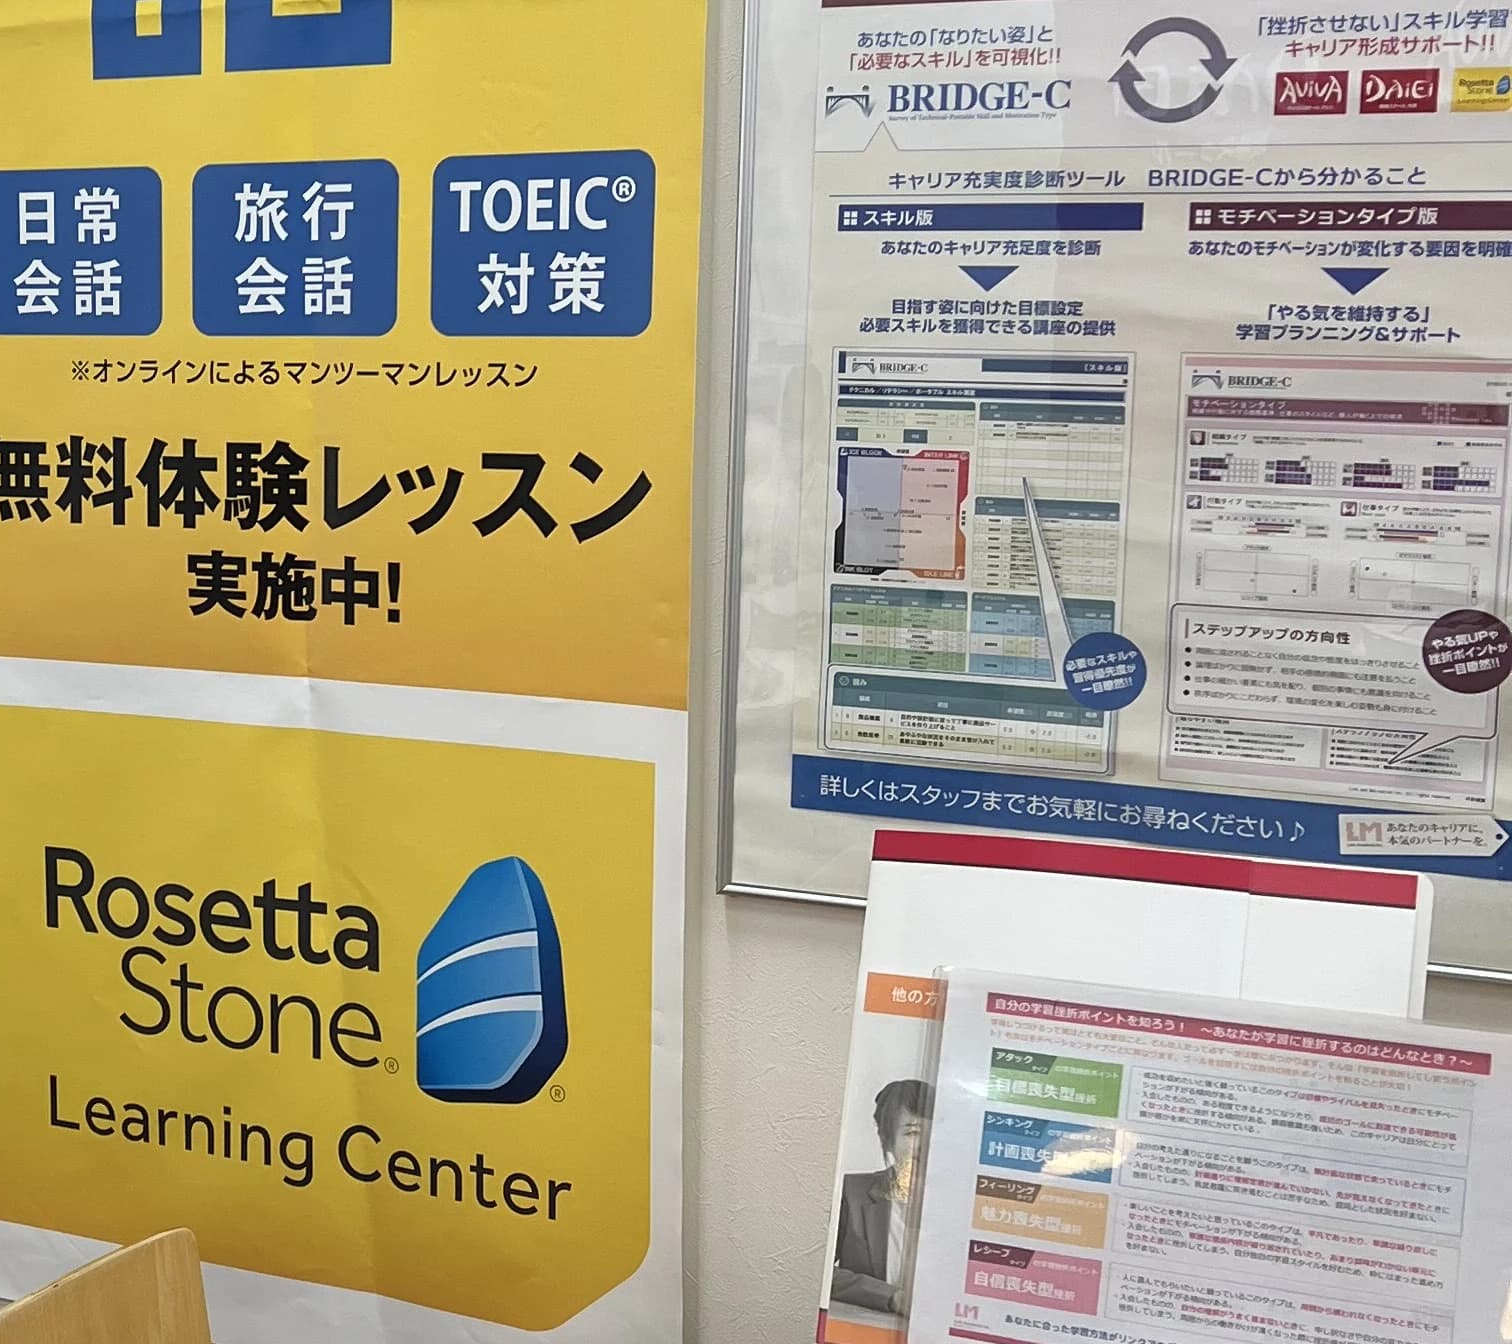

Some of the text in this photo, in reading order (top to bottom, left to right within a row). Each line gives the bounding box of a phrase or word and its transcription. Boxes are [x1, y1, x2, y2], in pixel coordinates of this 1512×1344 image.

[1257, 9, 1510, 37] 「挫折させない」スキル学習
[857, 25, 1053, 47] あなたの「なりたい姿」と
[887, 80, 1072, 112] BRIDGE-C
[889, 167, 1427, 190] キャリア充実度診断ツール BRIDGE-Cから分かること
[18, 187, 121, 245] 日常
[234, 181, 355, 243] 旅行
[863, 210, 933, 226] スキル版
[1218, 207, 1438, 226] モチベーションタイプ版
[881, 240, 1101, 256] あなたのキャリア充足度を診断
[13, 258, 123, 316] 会話
[235, 256, 354, 316] 会話
[477, 251, 607, 315] 対策
[891, 299, 1083, 316] 目指す姿に向けた目標設定
[1267, 304, 1430, 323] 「やる気を維持する」
[859, 319, 1116, 337] 必要スキルを獲得できる講座の提供
[71, 359, 538, 389] ※オンラインによるマンツーマンレッスン
[1227, 376, 1292, 389] BRIDGE-C
[1193, 622, 1351, 645] ステップアップの方向性
[44, 845, 381, 973] Rosetta
[48, 1075, 572, 1221] Learning Center
[979, 1178, 1035, 1194] フィーリング
